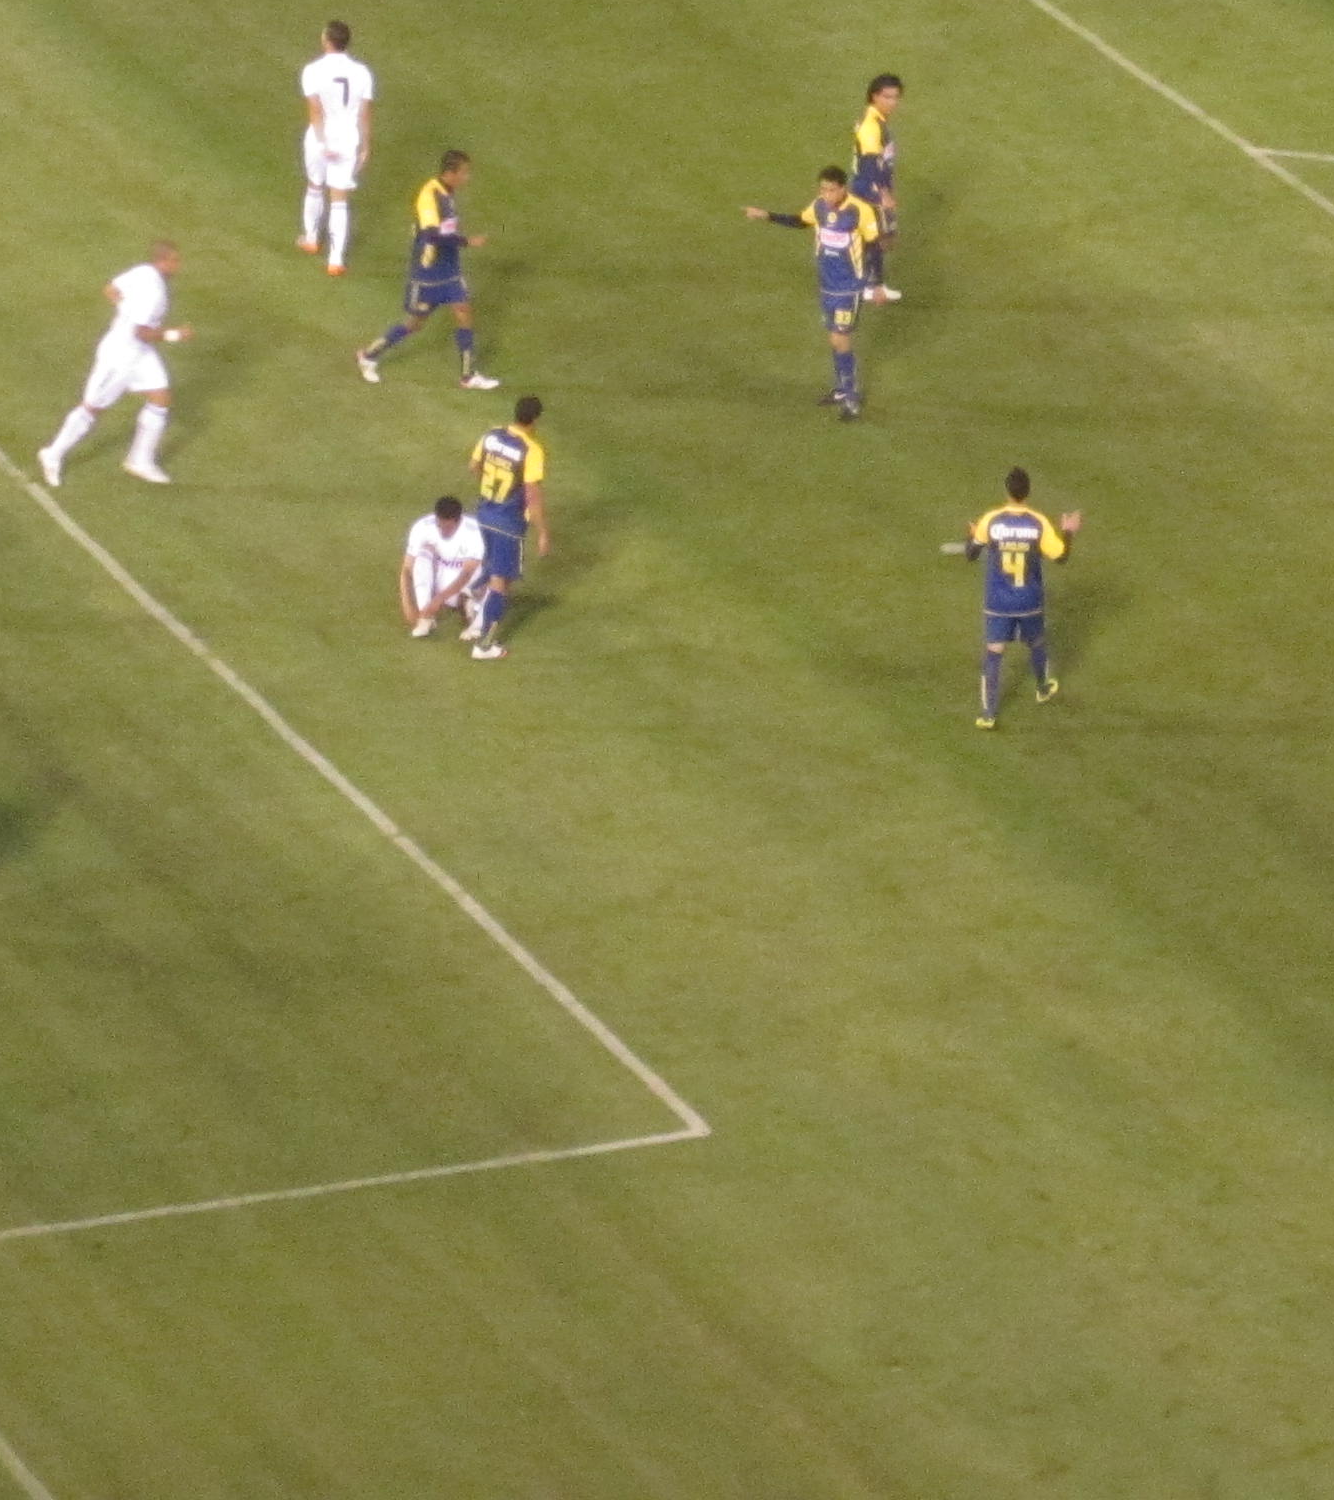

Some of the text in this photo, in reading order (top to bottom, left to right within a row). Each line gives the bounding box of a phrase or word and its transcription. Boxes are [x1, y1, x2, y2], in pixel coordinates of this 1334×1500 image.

[332, 76, 349, 107] 7
[481, 461, 515, 504] 27
[1002, 552, 1026, 588] 4
